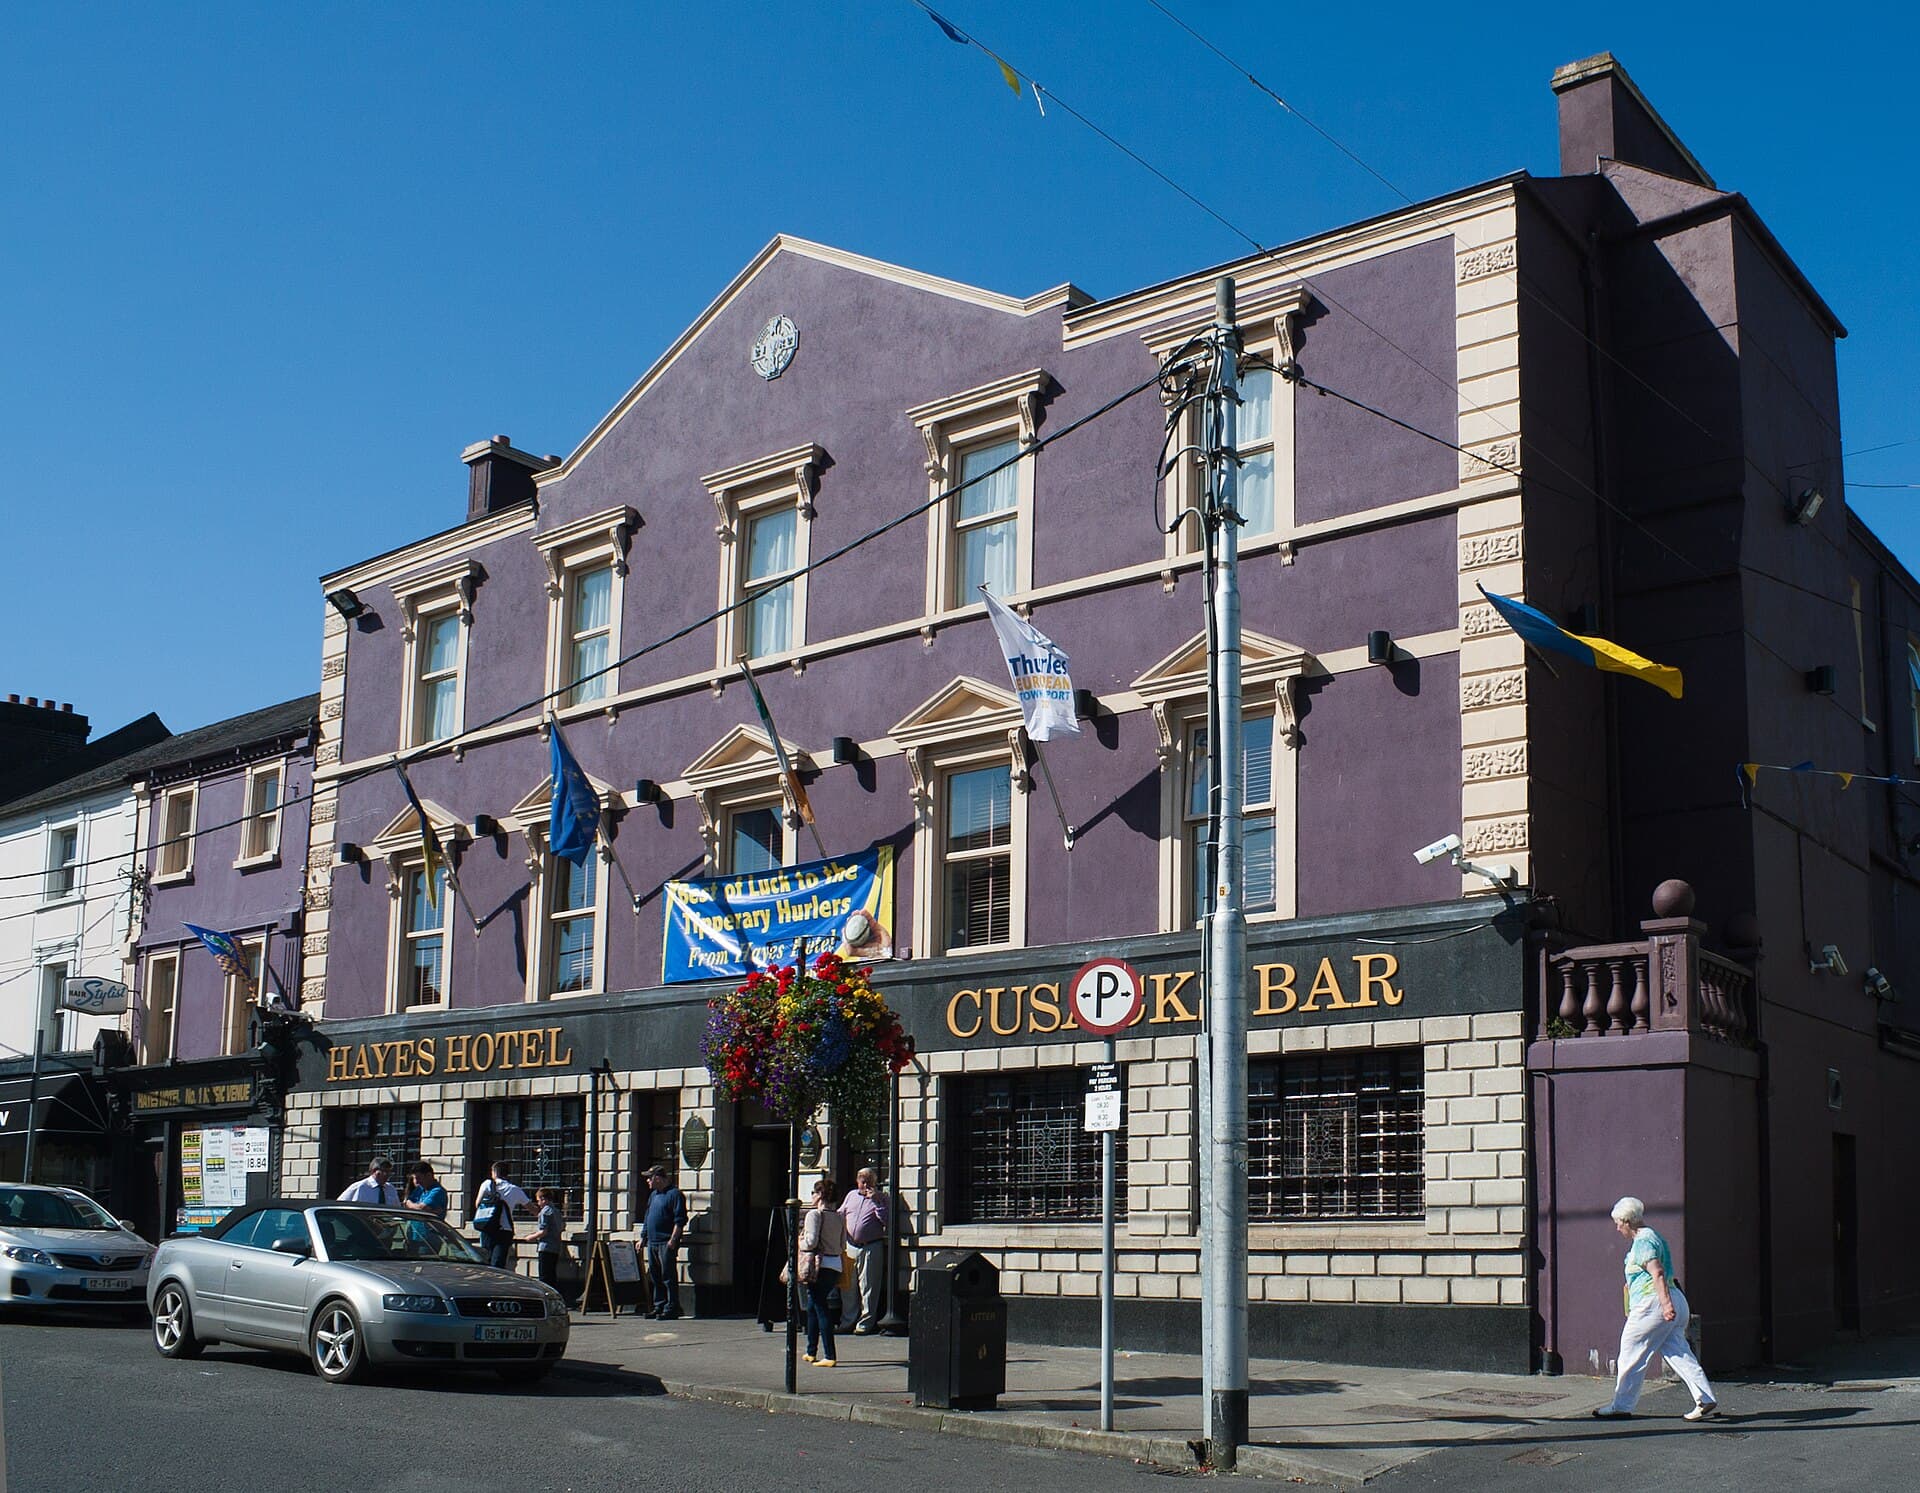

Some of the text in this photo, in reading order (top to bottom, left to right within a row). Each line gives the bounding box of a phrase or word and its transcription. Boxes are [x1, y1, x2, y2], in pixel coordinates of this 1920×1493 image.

[1009, 653, 1067, 676] Thurles
[725, 881, 742, 900] of
[749, 873, 791, 896] Luck
[796, 870, 819, 890] to
[823, 862, 858, 883] the
[683, 895, 852, 940] Tipperary Hurlers
[688, 946, 728, 968] From
[735, 941, 785, 967] Hayes
[69, 980, 126, 1007] HAIR Stylist
[1096, 971, 1119, 1018] P
[1253, 953, 1404, 1016] BAR
[327, 1027, 572, 1082] HAYES HOTEL
[227, 1083, 251, 1102] VENUE
[183, 1134, 201, 1144] FREE
[245, 1142, 251, 1153] 3
[184, 1176, 201, 1186] FREE
